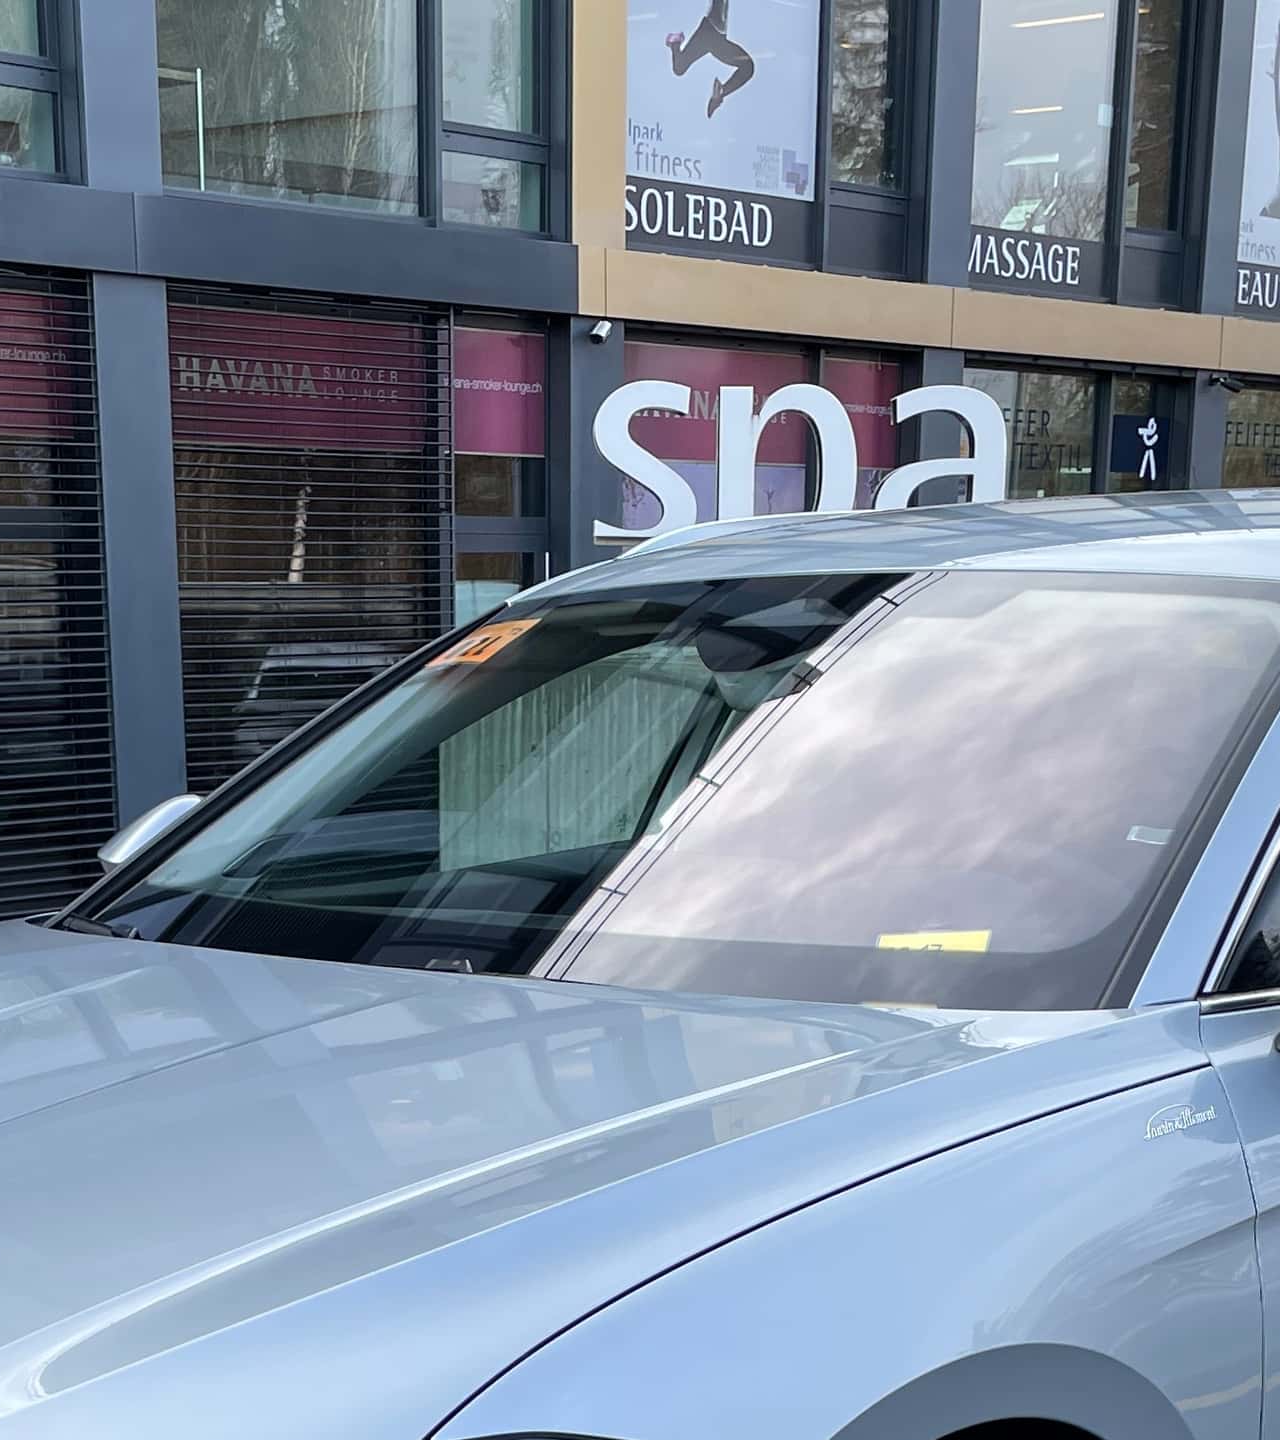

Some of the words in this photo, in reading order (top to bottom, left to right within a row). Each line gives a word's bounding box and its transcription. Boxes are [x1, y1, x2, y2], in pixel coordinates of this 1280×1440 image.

[634, 143, 702, 180] fitness
[624, 184, 773, 247] SOLEBAD
[177, 356, 322, 399] HAVANA
[323, 366, 399, 384] SMOKER
